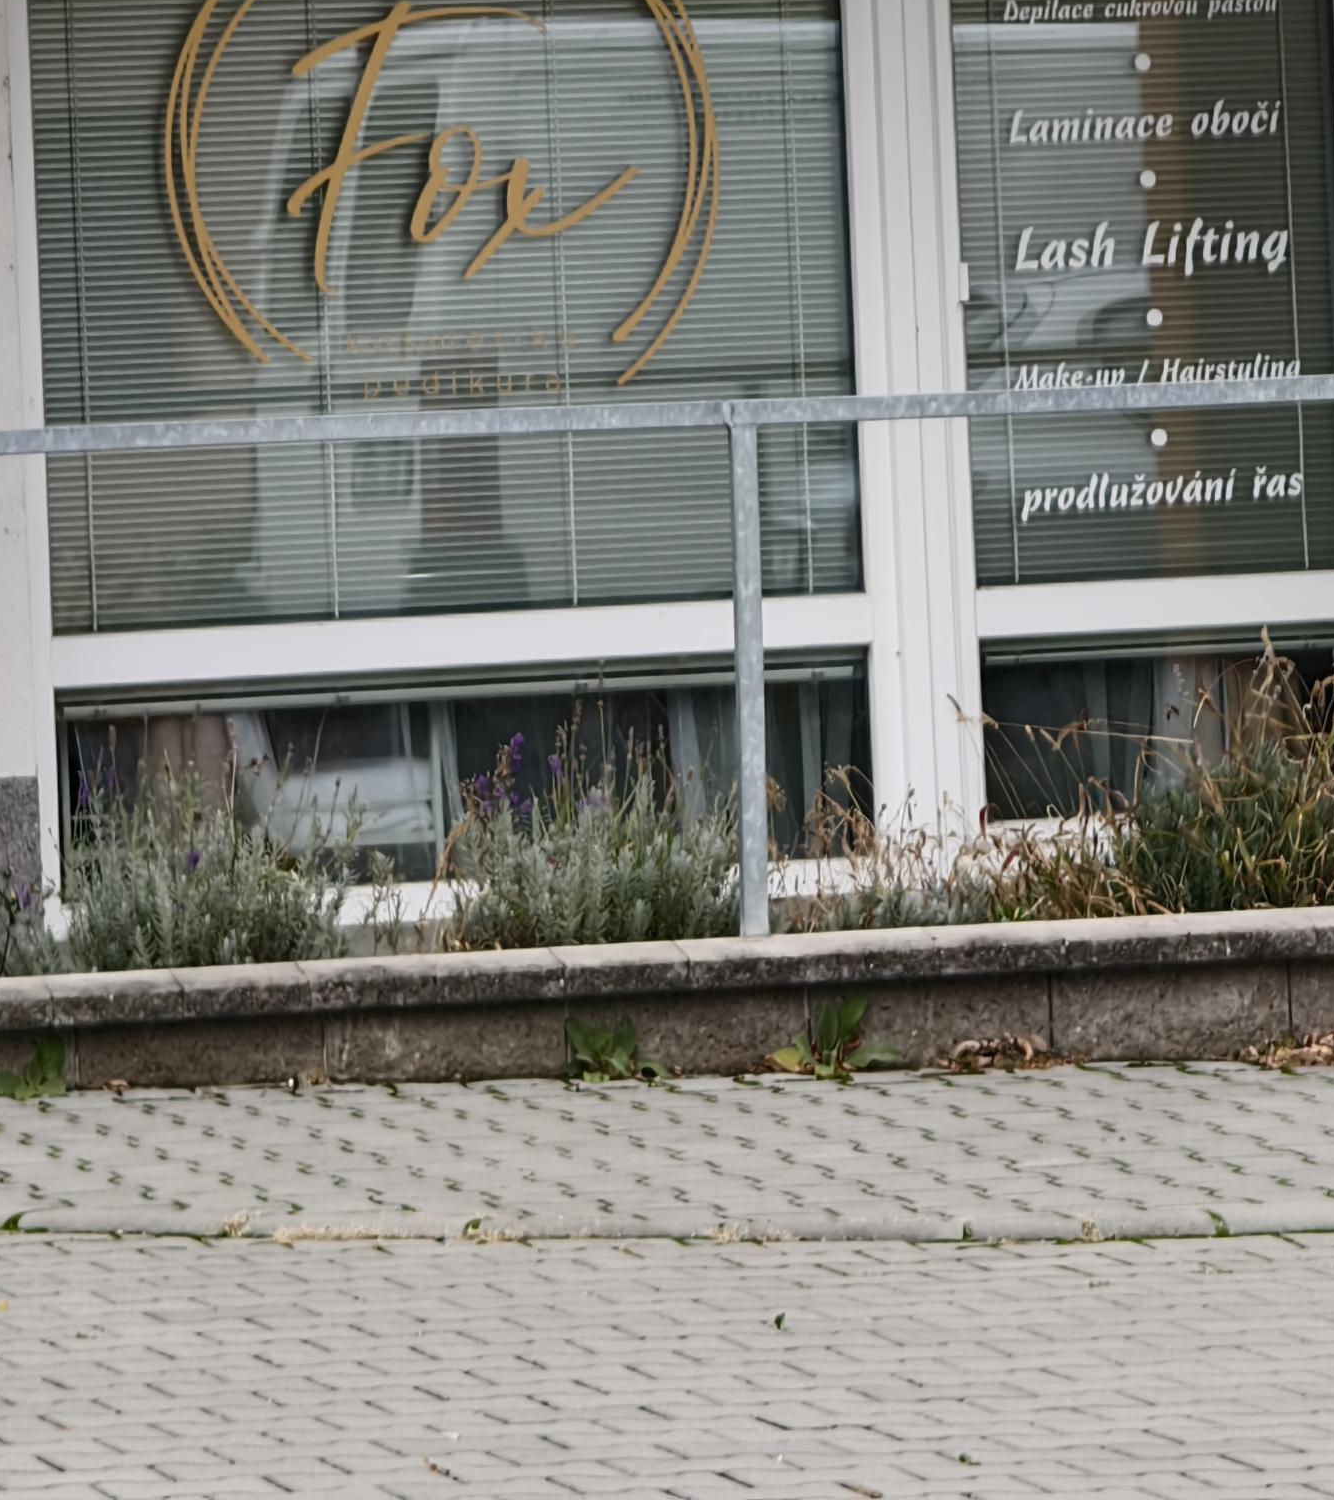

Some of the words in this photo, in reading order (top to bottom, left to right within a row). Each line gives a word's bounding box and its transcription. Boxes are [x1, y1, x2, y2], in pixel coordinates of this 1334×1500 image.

[286, 1, 639, 295] Fox
[1009, 109, 1174, 145] Laminace
[1190, 99, 1281, 137] obočí
[1015, 221, 1116, 272] Lash
[1141, 217, 1289, 276] Lifting
[1015, 361, 1127, 390] Make-up
[1020, 469, 1238, 522] prodlužování
[1252, 466, 1305, 499] řas
